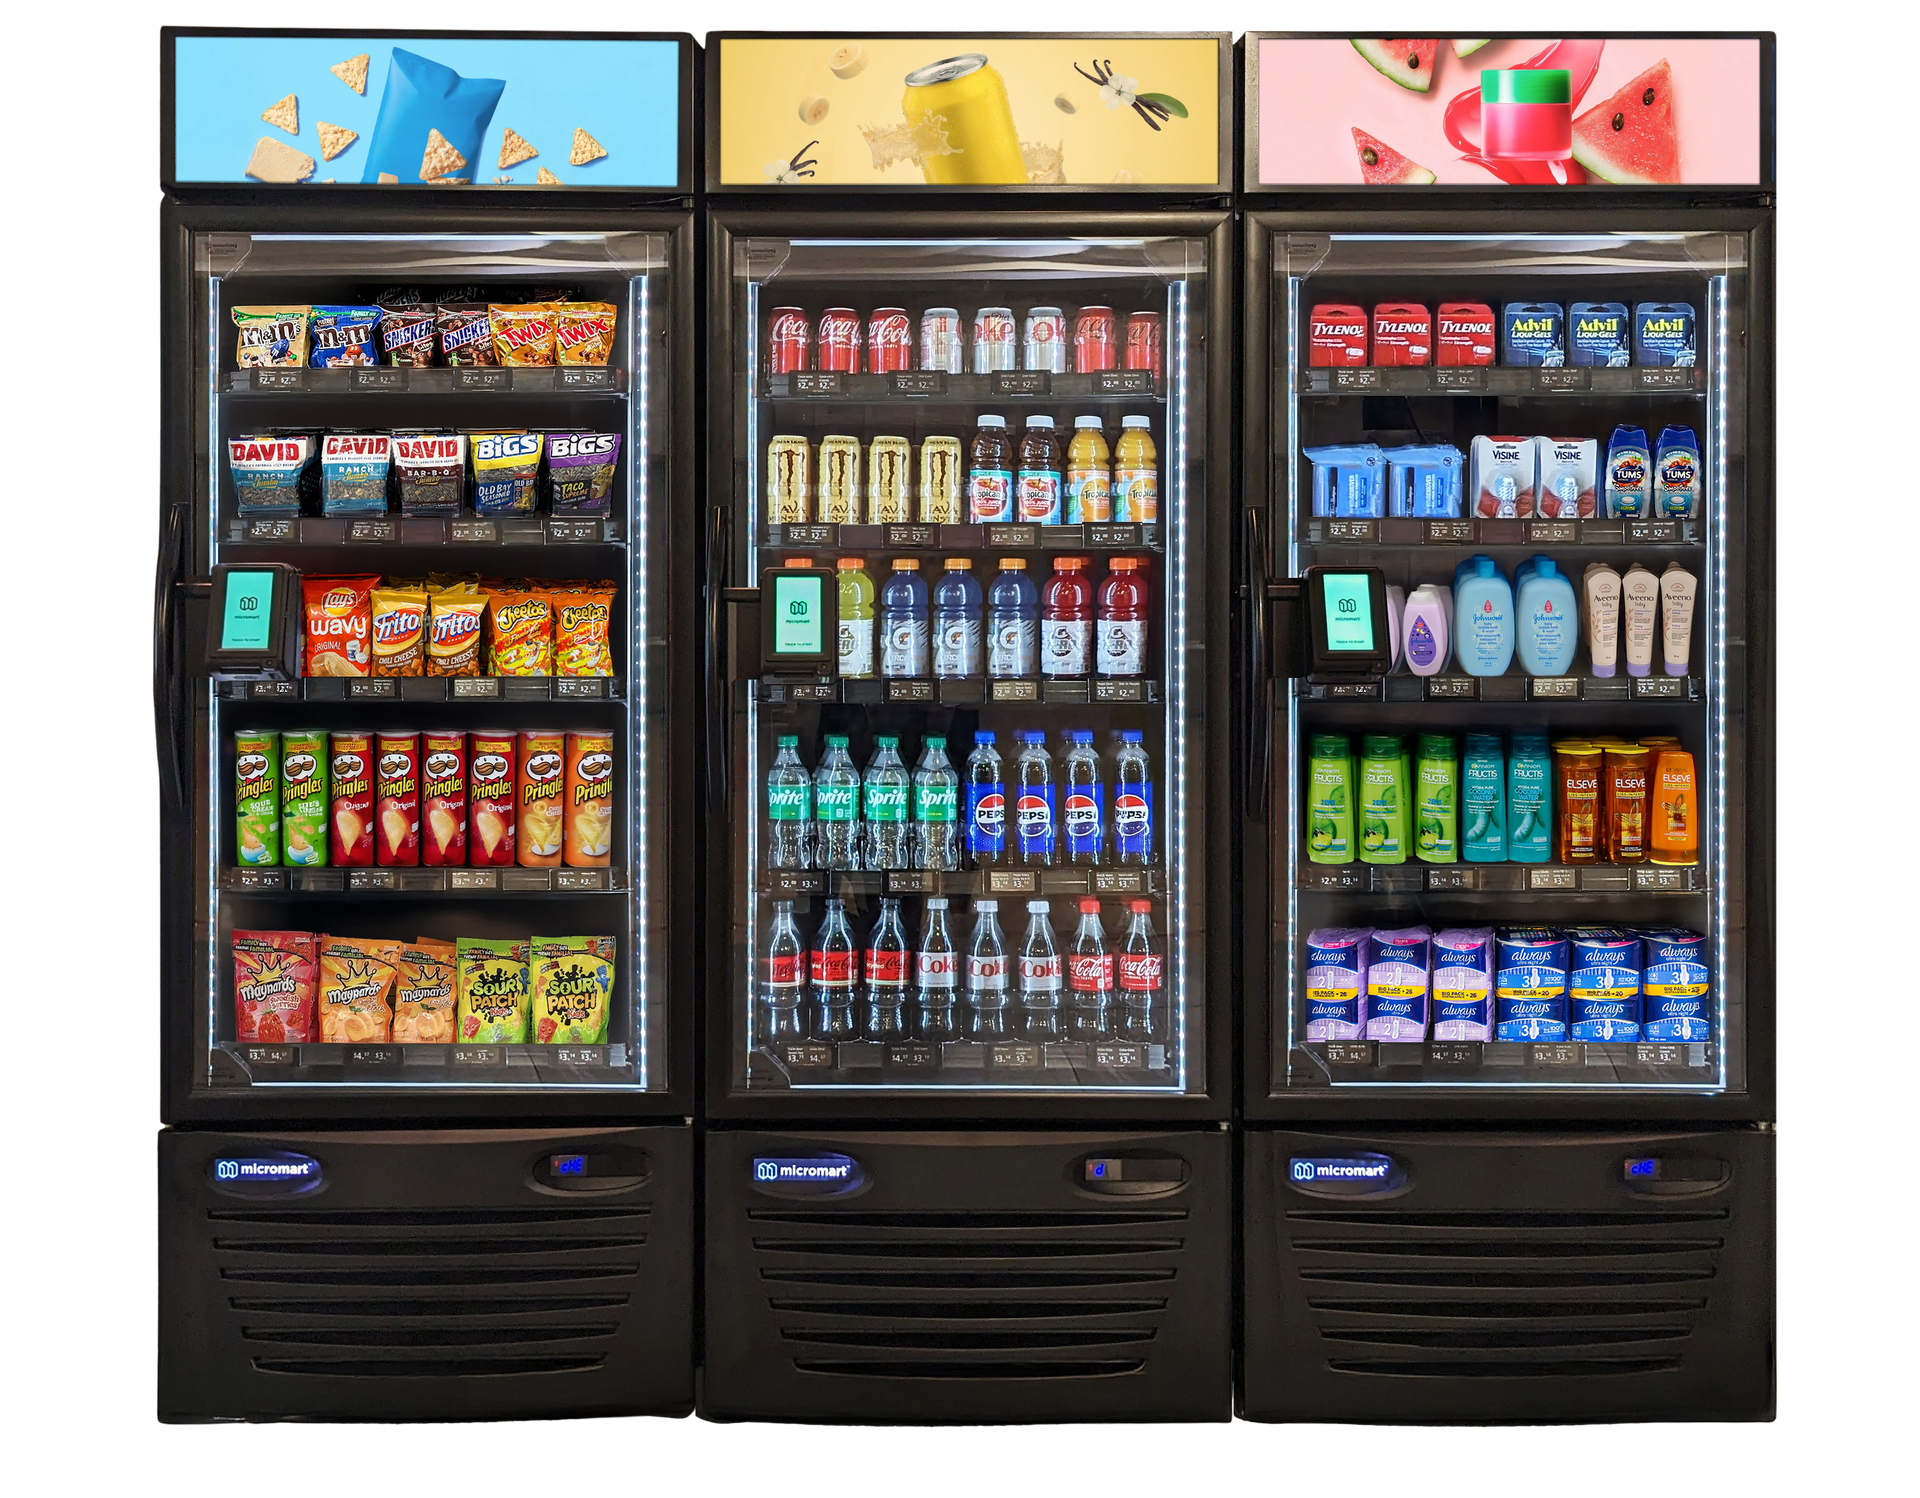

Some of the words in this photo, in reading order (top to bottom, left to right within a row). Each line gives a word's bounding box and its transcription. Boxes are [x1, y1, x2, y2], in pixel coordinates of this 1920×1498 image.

[1376, 321, 1427, 334] TYLENOL
[1440, 321, 1491, 334] TYLENOL
[1511, 318, 1552, 331] Advil
[1576, 318, 1617, 331] Advil
[1642, 318, 1683, 331] Advil
[443, 318, 490, 353] SNICKER
[233, 443, 299, 461] DAVID
[327, 437, 388, 455] DAVID
[397, 439, 458, 459] DAVID
[1493, 450, 1520, 460] VISINE
[1554, 450, 1581, 460] VISINE
[339, 466, 374, 474] RANCH
[1616, 471, 1641, 480] TUMS
[1666, 471, 1691, 480] TUMS
[478, 485, 496, 497] OLD
[561, 482, 584, 495] TACO
[325, 594, 355, 609] Lay's
[1593, 594, 1620, 602] Aveeno
[1627, 594, 1654, 602] Aveeno
[1664, 593, 1691, 601] Aveeno
[1672, 600, 1684, 608] baby
[499, 603, 546, 631] Cheetos
[311, 615, 367, 639] wavy
[374, 610, 421, 642] Frito
[394, 647, 418, 664] CHEESE
[1468, 771, 1497, 779] FRUCTIS
[1514, 771, 1543, 779] FRUCTIS
[1663, 774, 1690, 783] ELSEVE
[424, 777, 463, 802] Pringles
[1566, 779, 1597, 788] ELSEVE
[1615, 779, 1645, 788] ELSEVE
[471, 779, 512, 803] Pringles
[391, 800, 415, 810] Original
[486, 802, 512, 813] Original
[1018, 809, 1048, 820] PEPSI
[1066, 809, 1097, 820] PEPSI
[1380, 946, 1415, 960] always
[1441, 951, 1476, 964] always
[1511, 949, 1551, 964] always
[1585, 949, 1625, 964] always
[1660, 945, 1698, 961] always
[1319, 977, 1326, 988] 2
[1386, 973, 1393, 984] 2
[1449, 978, 1456, 989] 2
[473, 980, 517, 995] SOUR
[549, 979, 594, 994] SOUR
[473, 992, 518, 1012] PATCH
[550, 991, 595, 1013] PATCH
[1377, 1000, 1412, 1015] always
[1661, 1000, 1700, 1016] always
[1312, 1003, 1347, 1018] always
[1442, 1004, 1477, 1018] always
[1510, 1001, 1550, 1017] always
[1584, 1001, 1624, 1018] always
[1450, 1027, 1457, 1038] 2
[1522, 1025, 1529, 1036] 3
[1595, 1025, 1602, 1037] 3
[1673, 1024, 1680, 1036] 3
[241, 1163, 309, 1175] micromart
[780, 1165, 848, 1177] micromart
[1317, 1165, 1385, 1177] micromart
